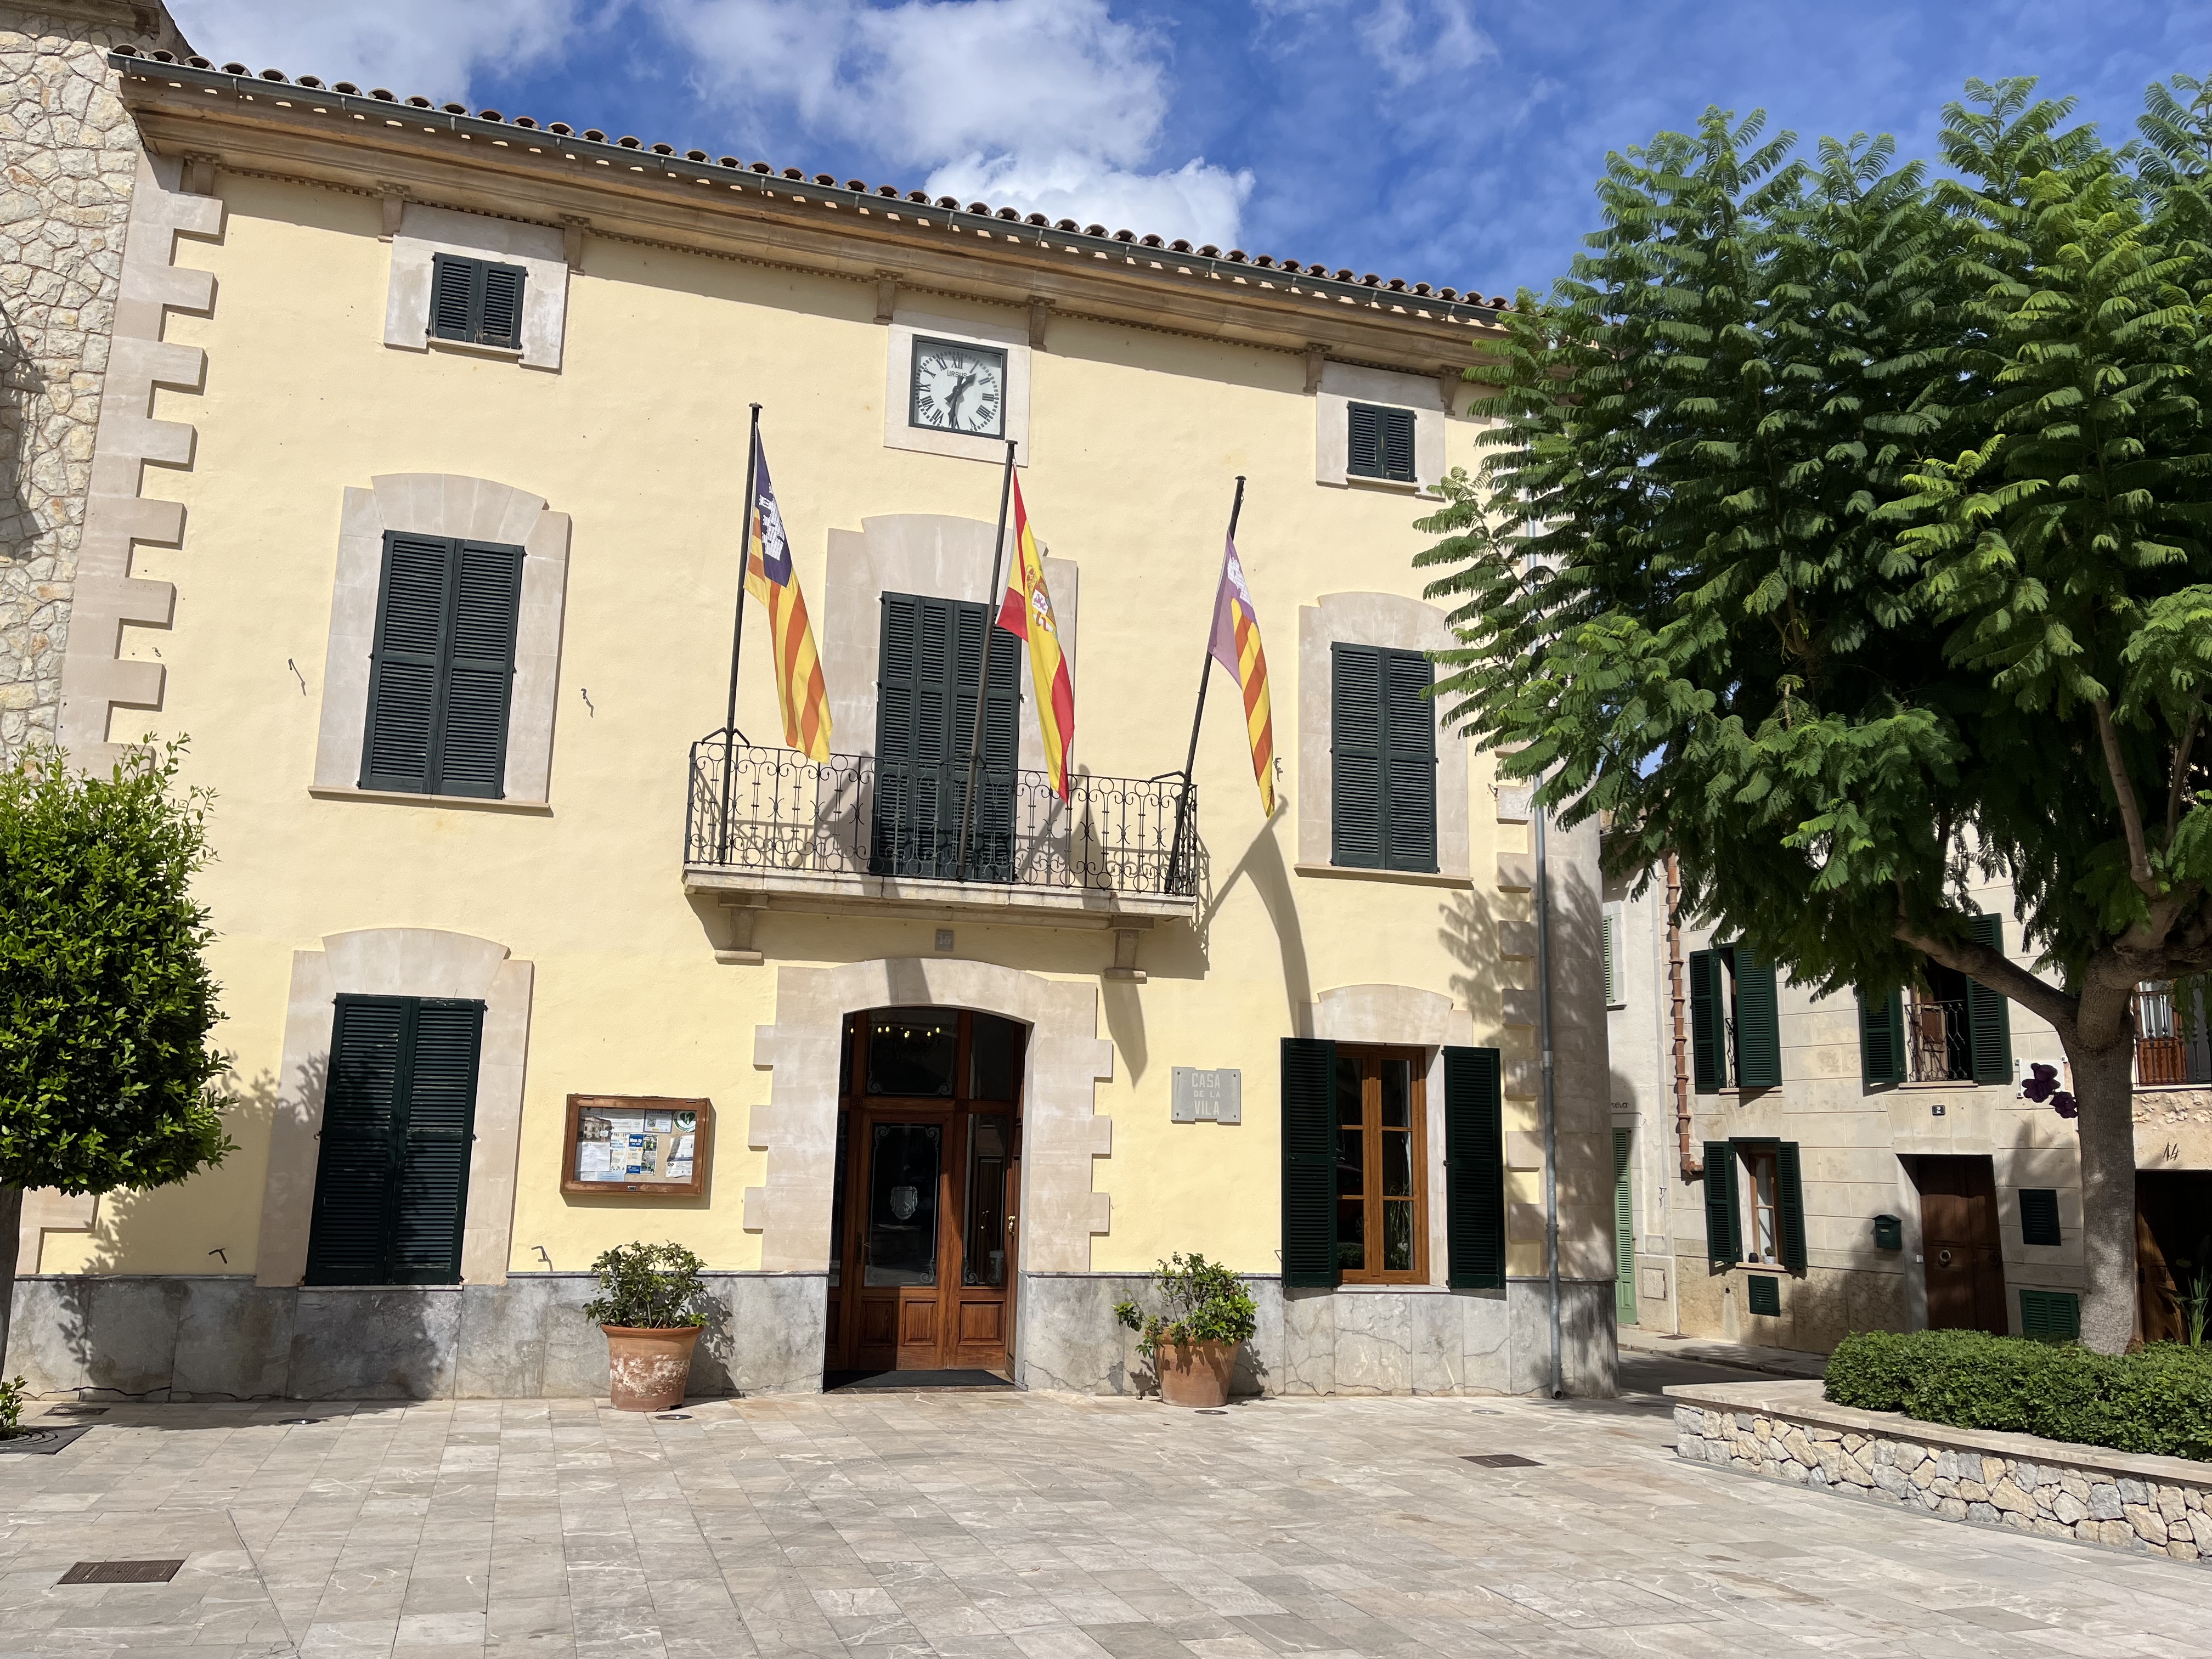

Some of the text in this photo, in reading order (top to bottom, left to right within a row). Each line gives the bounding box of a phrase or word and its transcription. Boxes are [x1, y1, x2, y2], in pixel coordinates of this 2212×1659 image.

[935, 357, 948, 371] XI
[951, 356, 963, 369] XII
[923, 368, 936, 379] X
[947, 370, 968, 379] URSUS
[916, 381, 930, 392] IX
[978, 377, 991, 385] II
[982, 393, 994, 402] III
[938, 933, 951, 945] 15
[1192, 1073, 1221, 1088] CASA
[1194, 1100, 1220, 1115] VILA
[2163, 1142, 2181, 1162] 14
